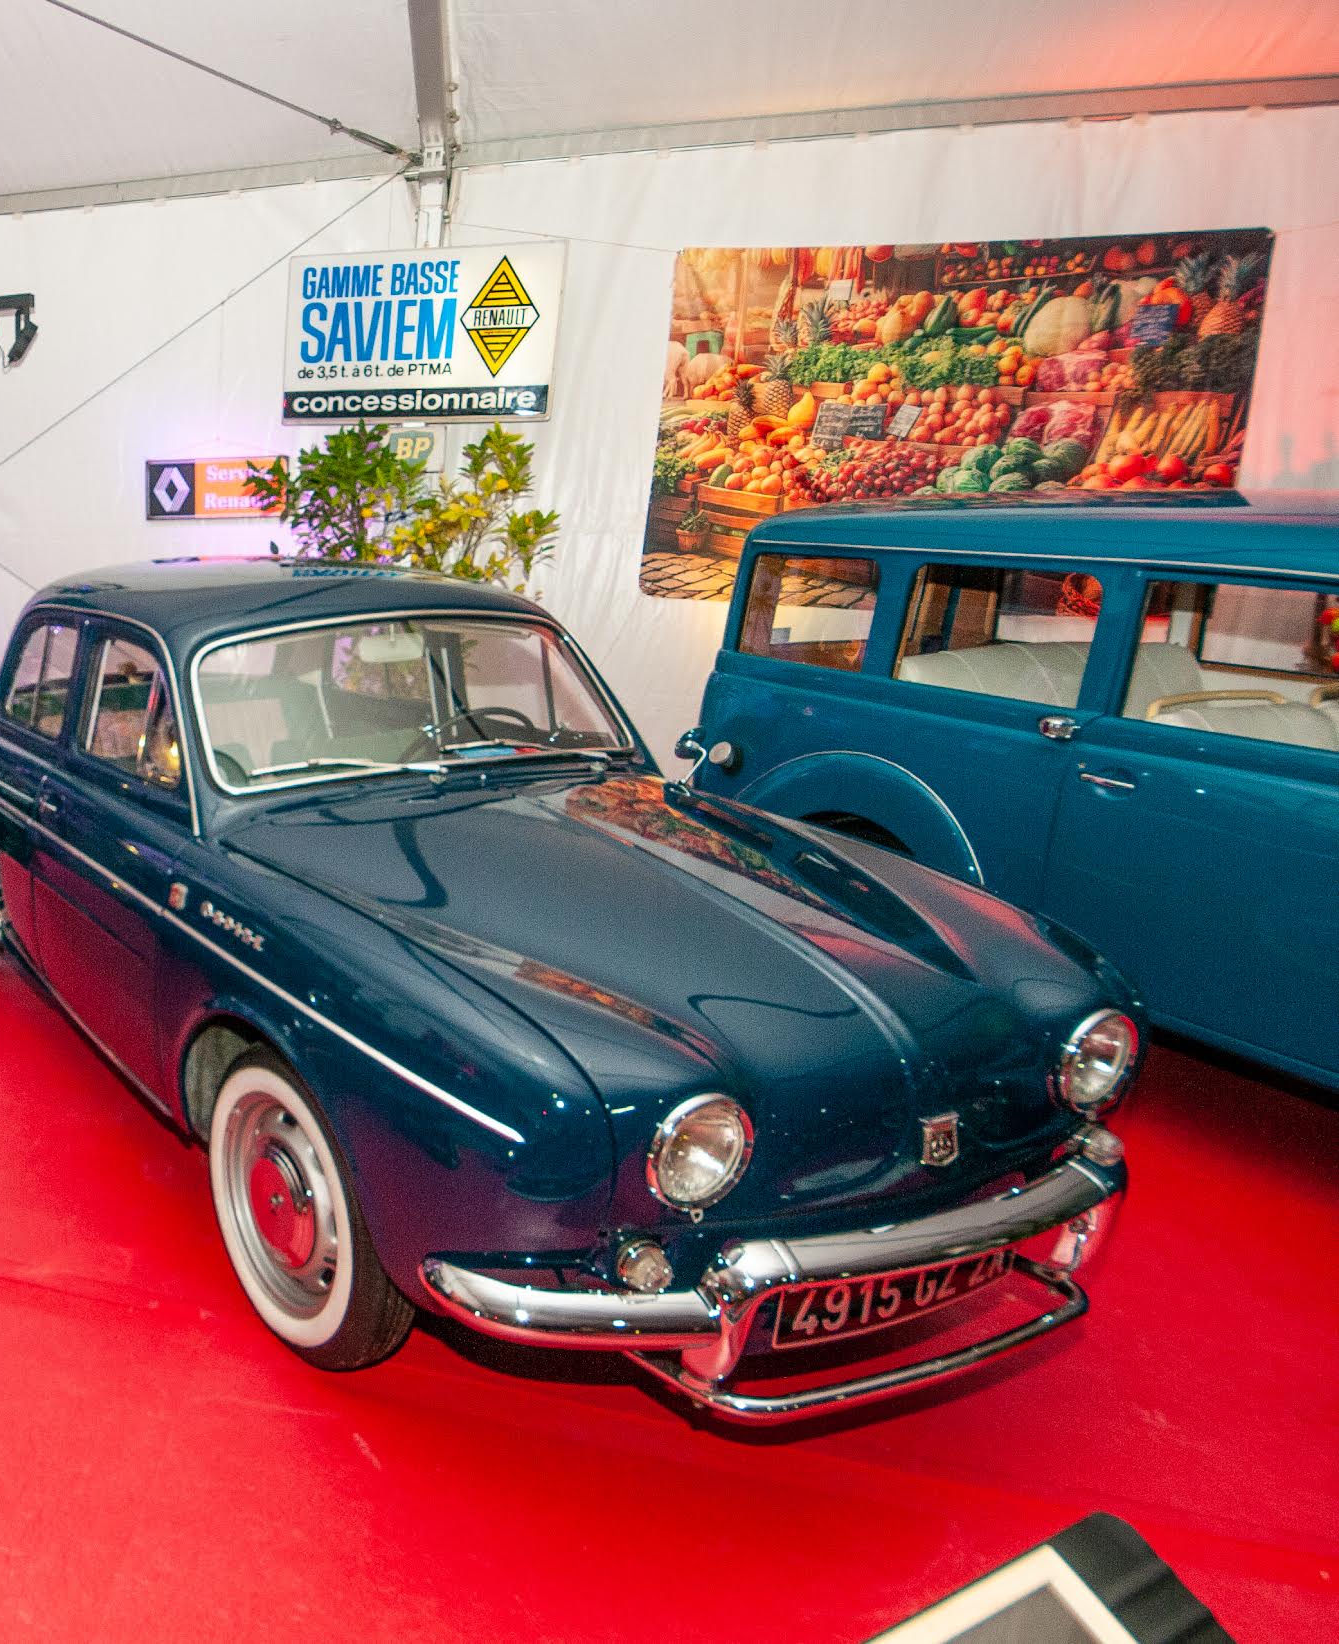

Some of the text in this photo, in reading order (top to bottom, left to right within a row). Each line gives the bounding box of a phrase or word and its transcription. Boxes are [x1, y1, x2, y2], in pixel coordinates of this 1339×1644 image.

[302, 261, 460, 299] GAMME BASSE
[474, 308, 528, 326] RENAULT
[300, 298, 458, 364] SAVIEM
[298, 362, 452, 380] de 3,5 t. à 6 t. de PTMA
[292, 387, 537, 413] concessionnaire
[396, 437, 431, 460] BP
[791, 1277, 902, 1335] 4915
